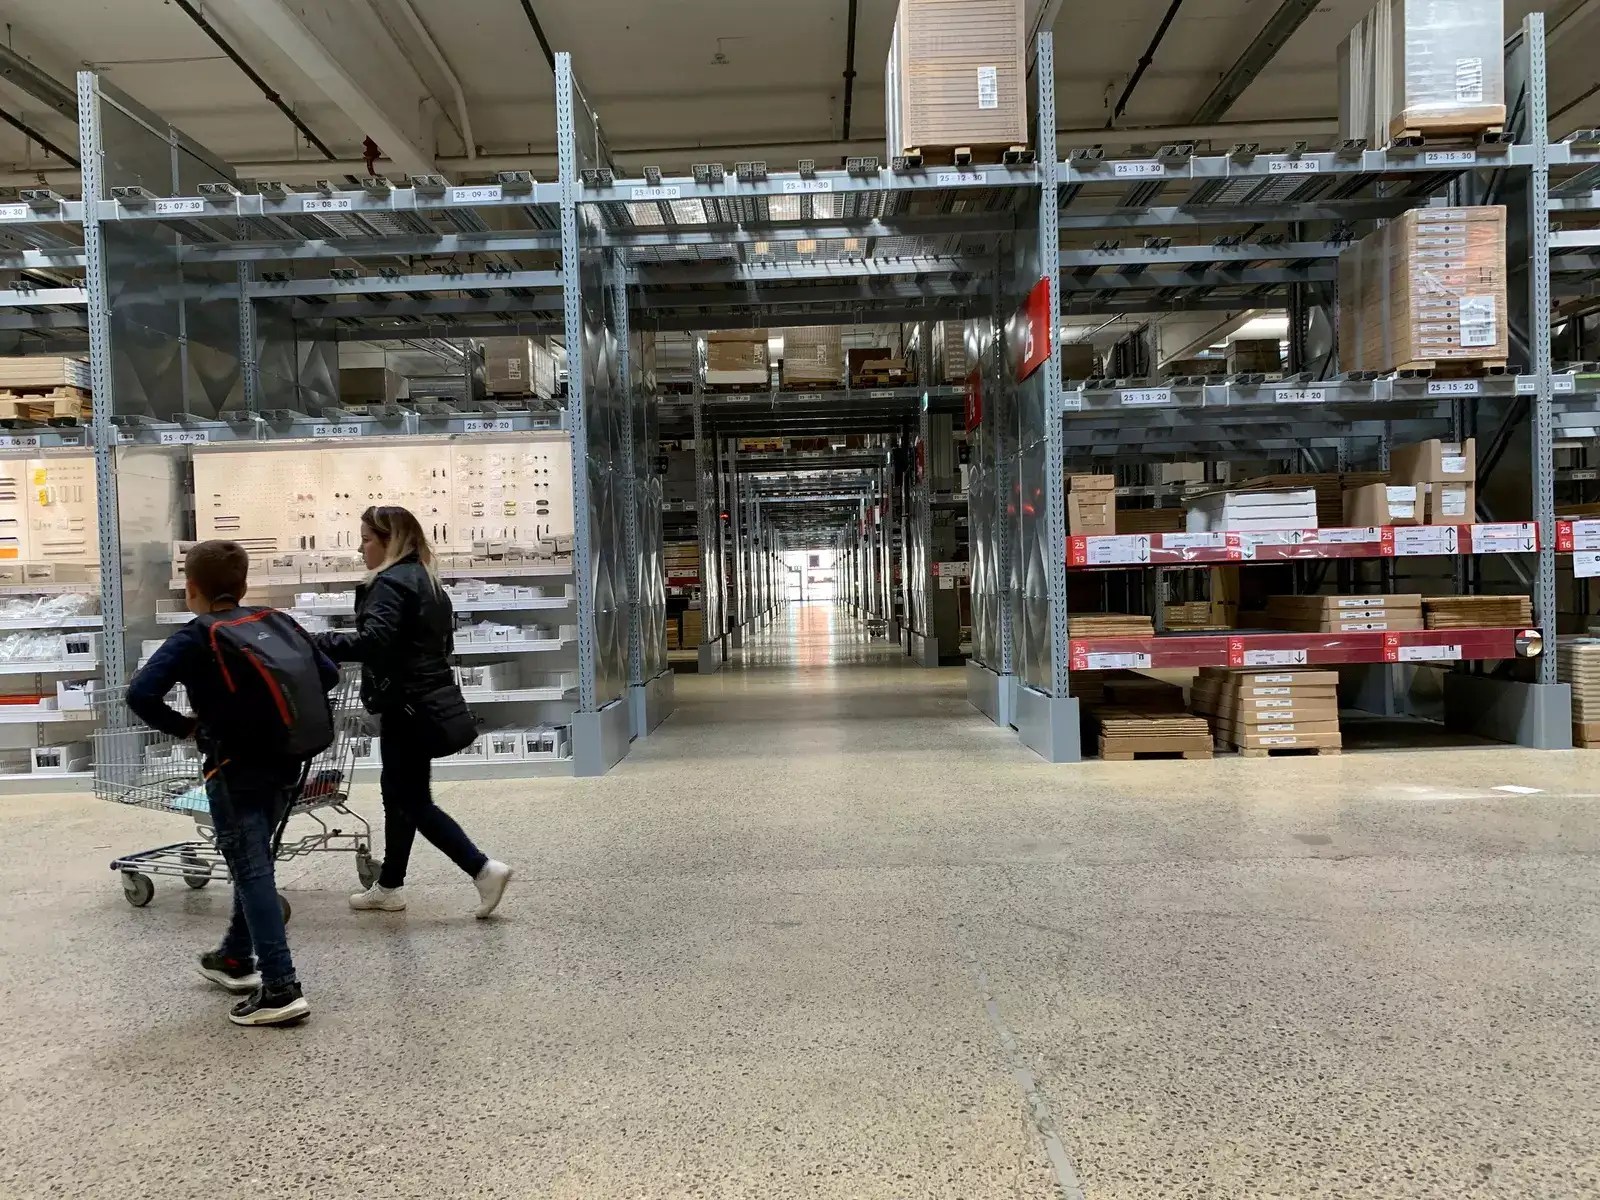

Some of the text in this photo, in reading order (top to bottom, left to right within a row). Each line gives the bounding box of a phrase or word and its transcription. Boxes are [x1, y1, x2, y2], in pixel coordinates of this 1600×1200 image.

[1382, 532, 1393, 540] 25
[1561, 541, 1571, 549] 16
[1232, 642, 1242, 650] 25
